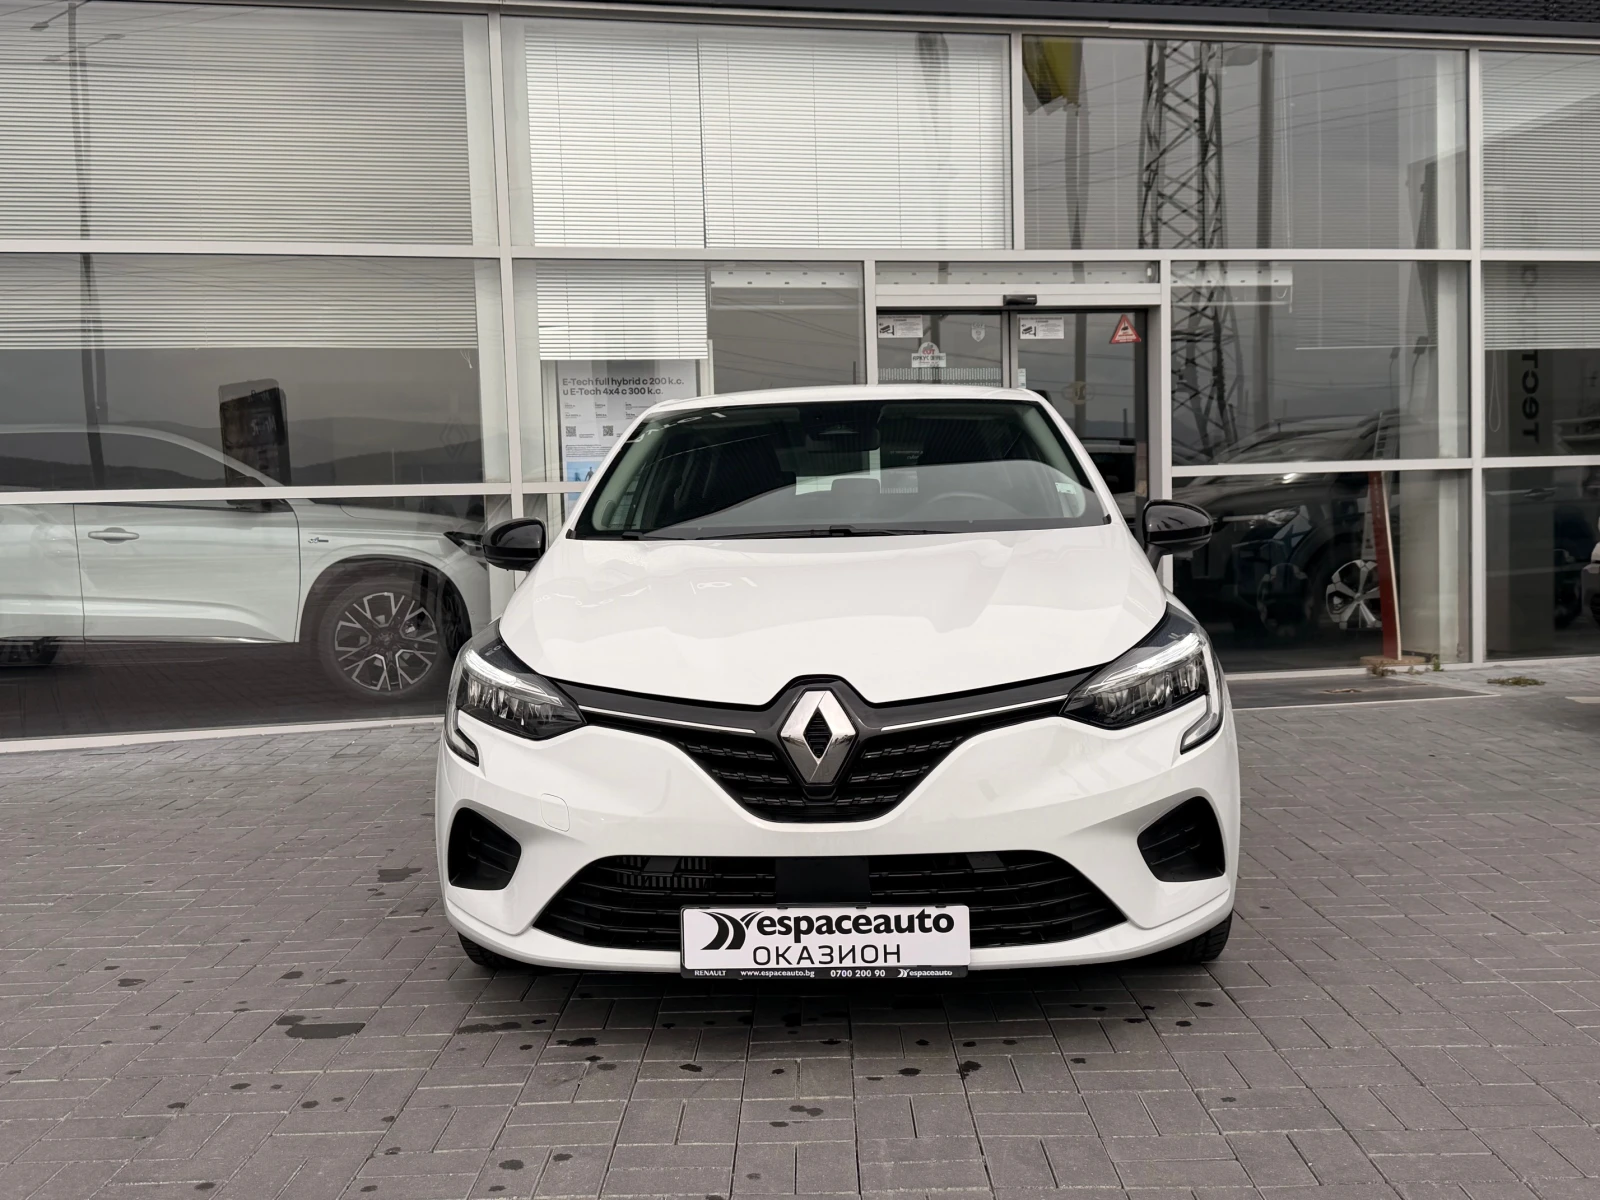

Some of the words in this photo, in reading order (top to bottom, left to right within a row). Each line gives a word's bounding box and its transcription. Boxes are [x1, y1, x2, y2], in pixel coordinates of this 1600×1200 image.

[562, 378, 593, 386] E-Tech
[595, 377, 610, 386] full
[611, 377, 641, 387] hybrid
[649, 377, 667, 385] 200
[628, 387, 646, 395] 300
[756, 908, 955, 944] espaceauto
[752, 943, 901, 966] ОКАЗИОН
[740, 969, 815, 977] www.espaceauto.bg
[830, 969, 853, 977] 0700
[855, 969, 872, 977] 200
[874, 969, 886, 977] 90
[909, 969, 953, 977] espaceauto
